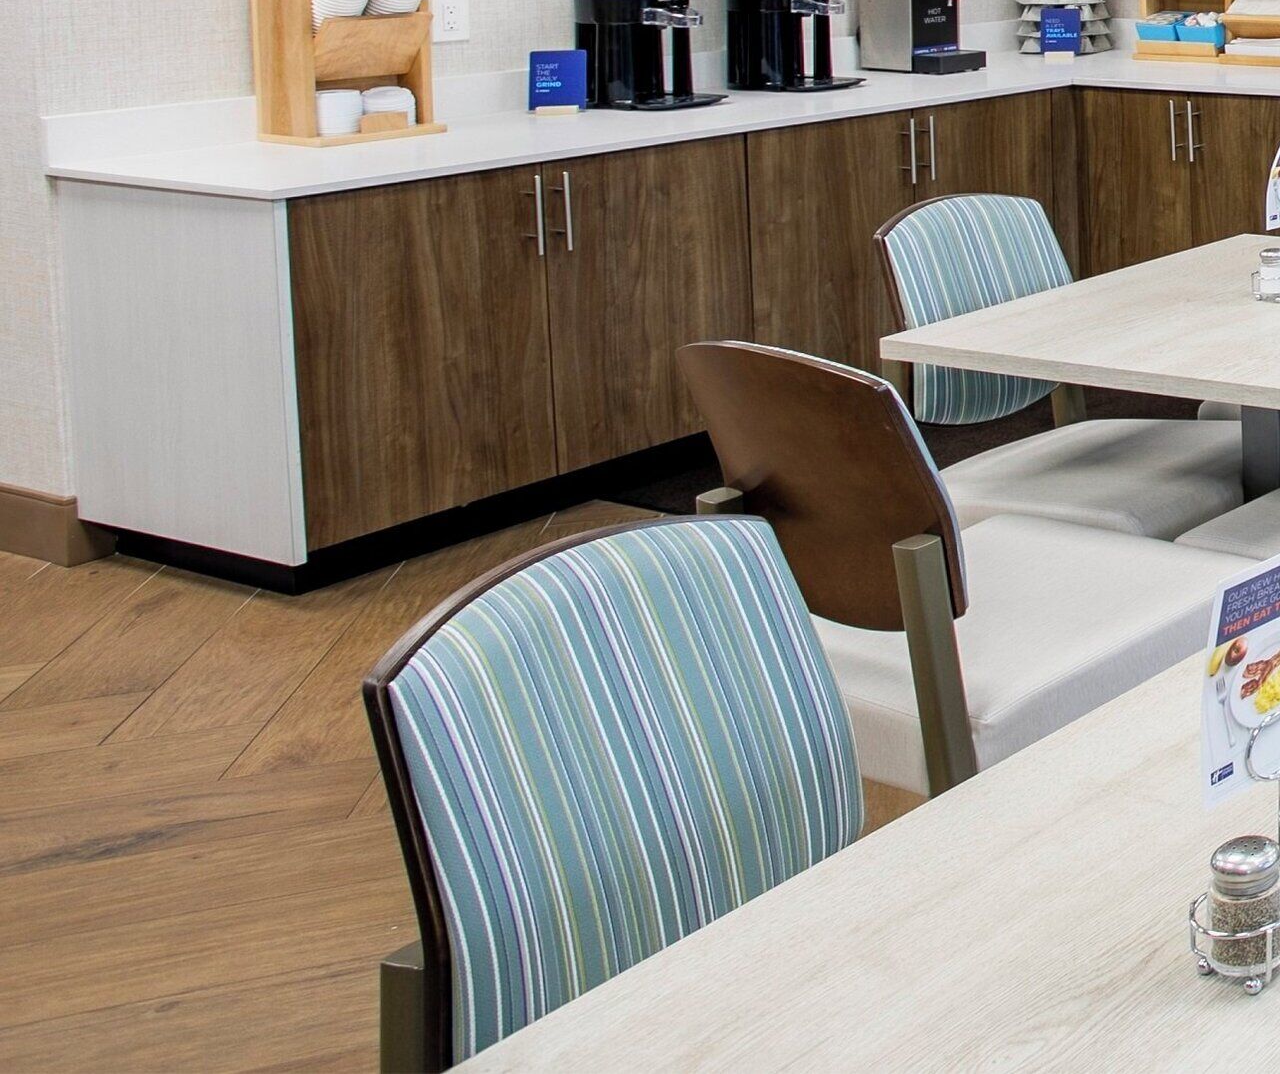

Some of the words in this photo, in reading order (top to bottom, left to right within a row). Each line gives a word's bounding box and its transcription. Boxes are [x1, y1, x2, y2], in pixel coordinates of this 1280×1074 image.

[923, 15, 946, 24] WATER
[928, 7, 941, 15] HOT
[1228, 588, 1248, 603] OUR
[1250, 578, 1272, 593] NEW
[1225, 608, 1245, 623] YOU
[1245, 598, 1267, 614] MAKE
[1226, 595, 1255, 614] FRESH
[1223, 618, 1250, 636] THEN
[1253, 607, 1272, 621] EAT
